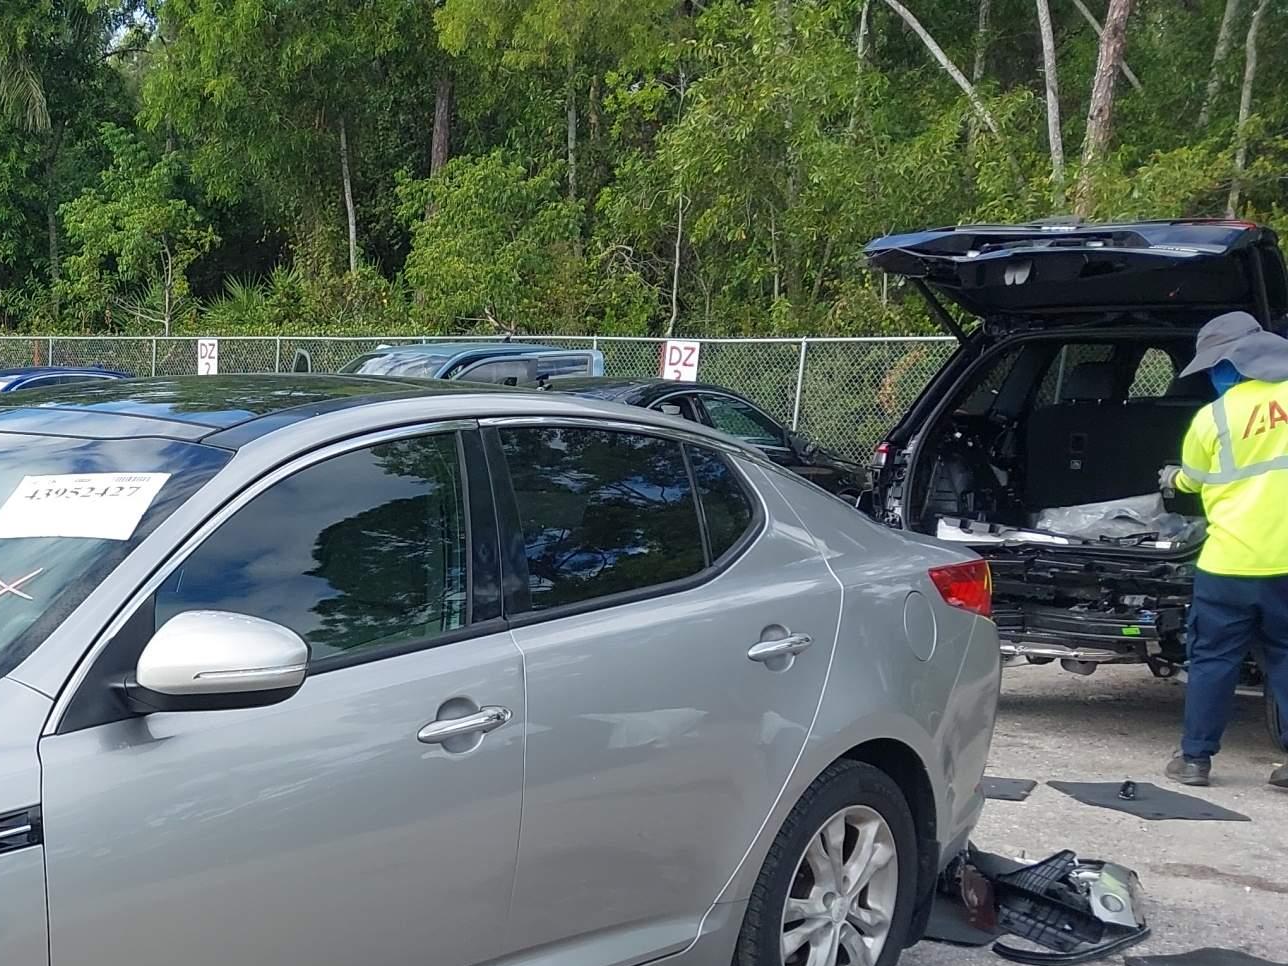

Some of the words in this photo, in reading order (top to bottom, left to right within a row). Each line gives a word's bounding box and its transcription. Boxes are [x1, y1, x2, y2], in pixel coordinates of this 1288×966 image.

[200, 342, 216, 359] DZ
[668, 346, 697, 367] DZ
[24, 485, 142, 500] 43952427
